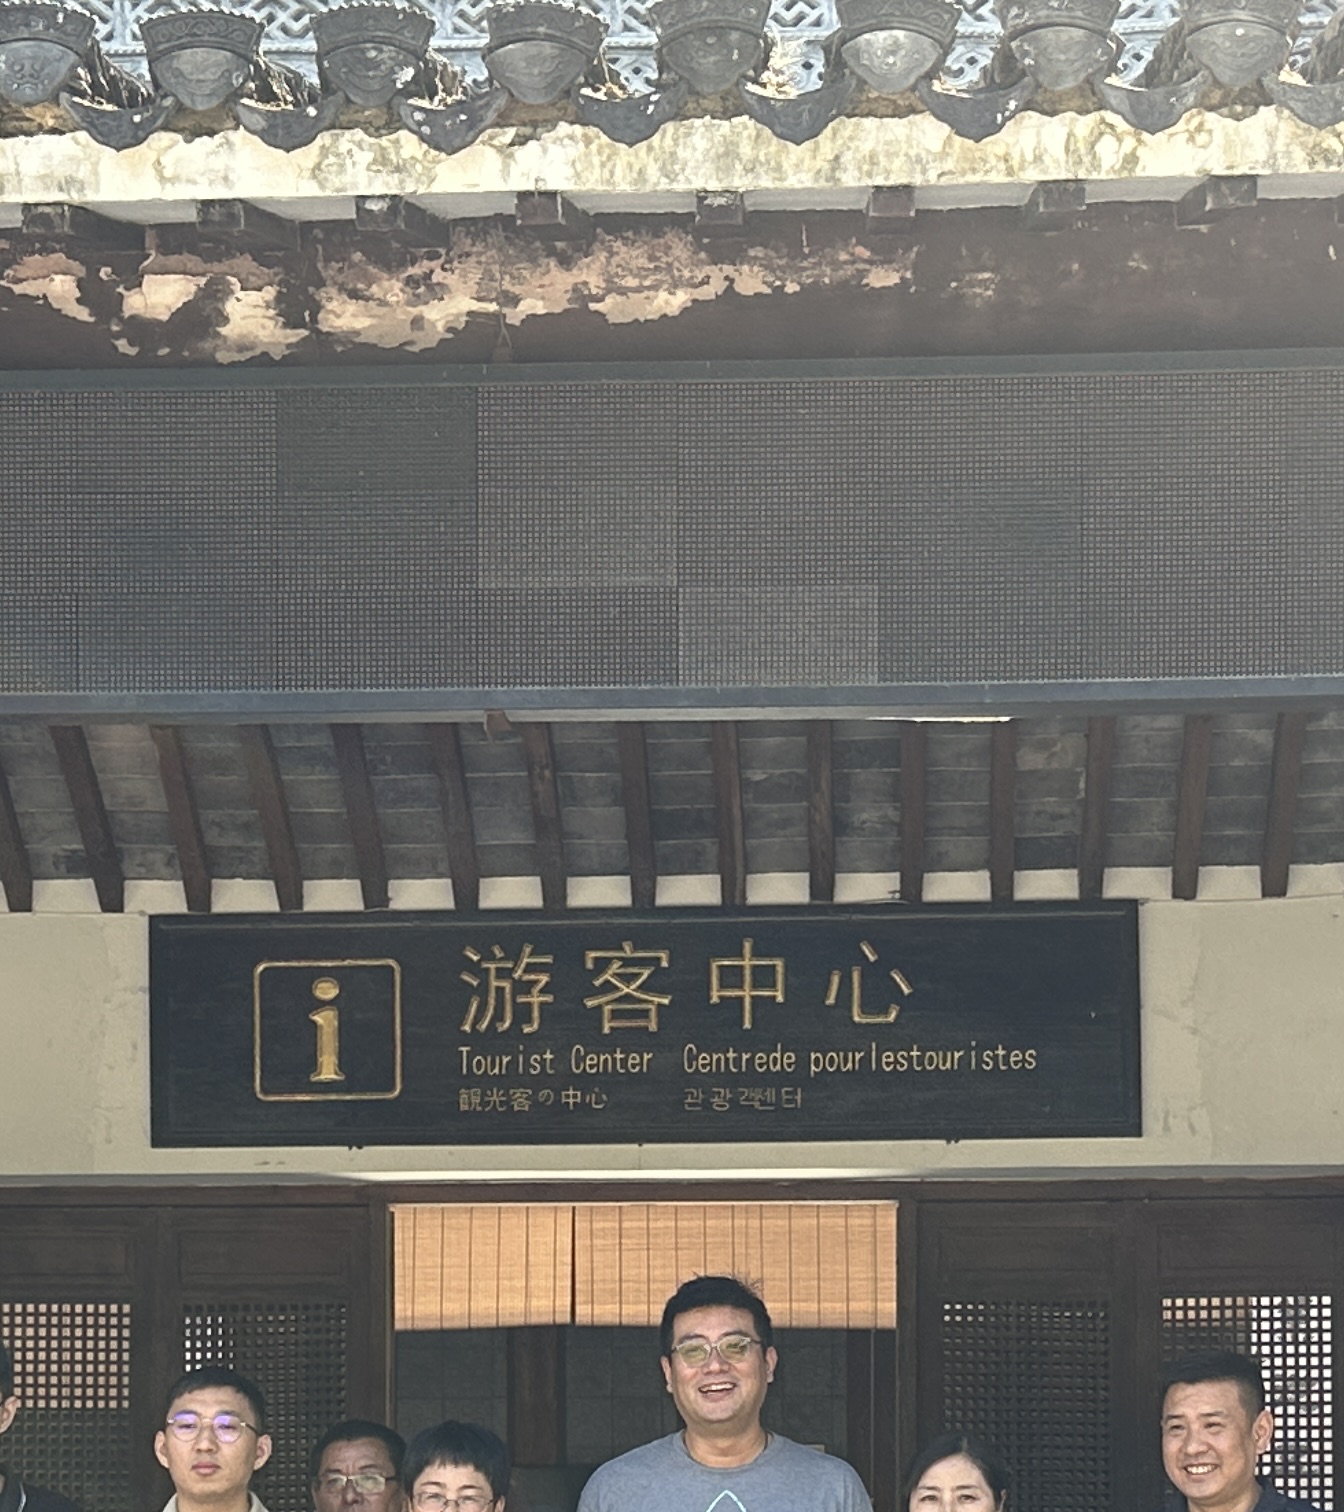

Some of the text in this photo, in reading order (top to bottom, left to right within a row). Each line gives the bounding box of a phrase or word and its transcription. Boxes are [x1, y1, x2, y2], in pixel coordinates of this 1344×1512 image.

[459, 938, 914, 1034] 游客中心
[457, 1041, 1038, 1077] Tourist Center Centrede pourlestouristes
